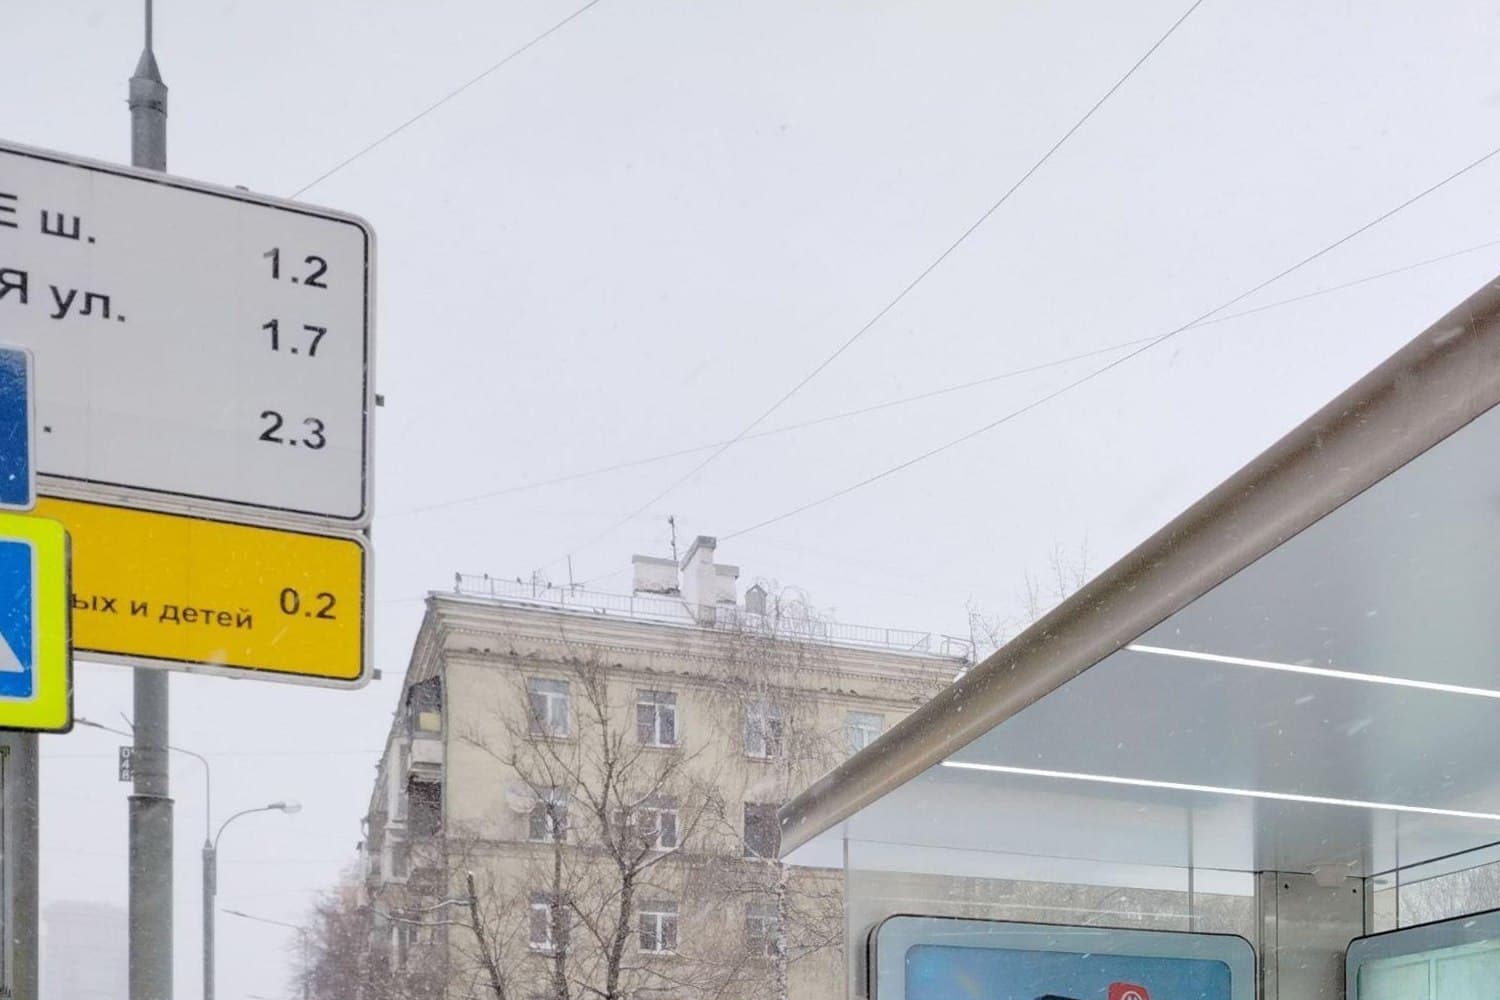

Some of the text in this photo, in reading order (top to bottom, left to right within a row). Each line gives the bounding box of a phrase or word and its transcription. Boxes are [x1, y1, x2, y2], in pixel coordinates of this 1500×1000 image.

[40, 209, 96, 244] ш.
[263, 247, 328, 289] 1.2
[48, 284, 126, 323] ул.
[262, 318, 327, 357] 1.7
[258, 410, 326, 450] 2.3
[130, 600, 148, 617] и
[158, 604, 253, 630] детей
[279, 587, 337, 620] 0.2
